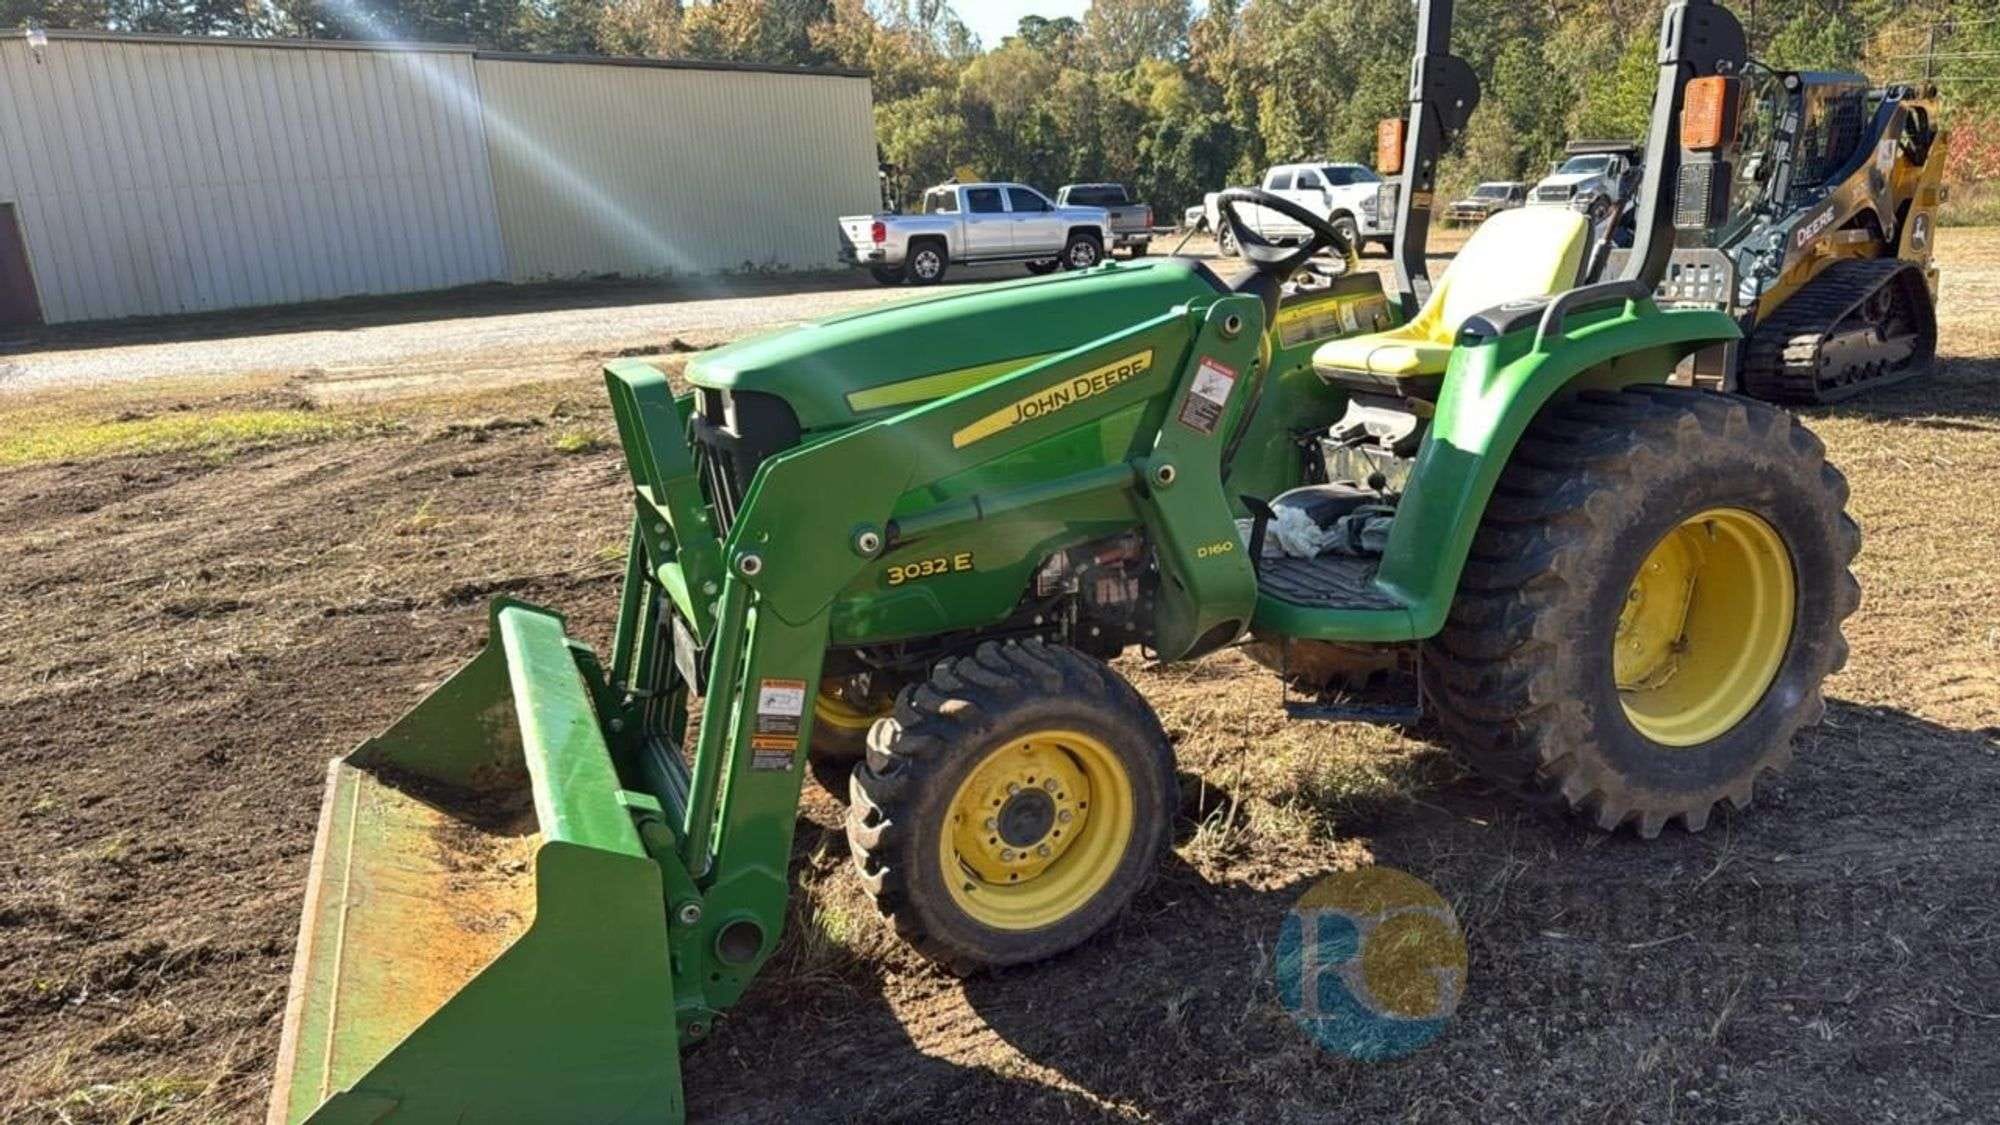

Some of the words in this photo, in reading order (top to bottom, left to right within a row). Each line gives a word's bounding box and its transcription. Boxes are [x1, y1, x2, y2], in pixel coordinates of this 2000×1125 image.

[1797, 205, 1835, 247] DEERE
[1011, 388, 1070, 425] JOHN
[1073, 360, 1144, 398] DEERE
[1197, 541, 1233, 558] D160
[887, 556, 948, 585] 3032
